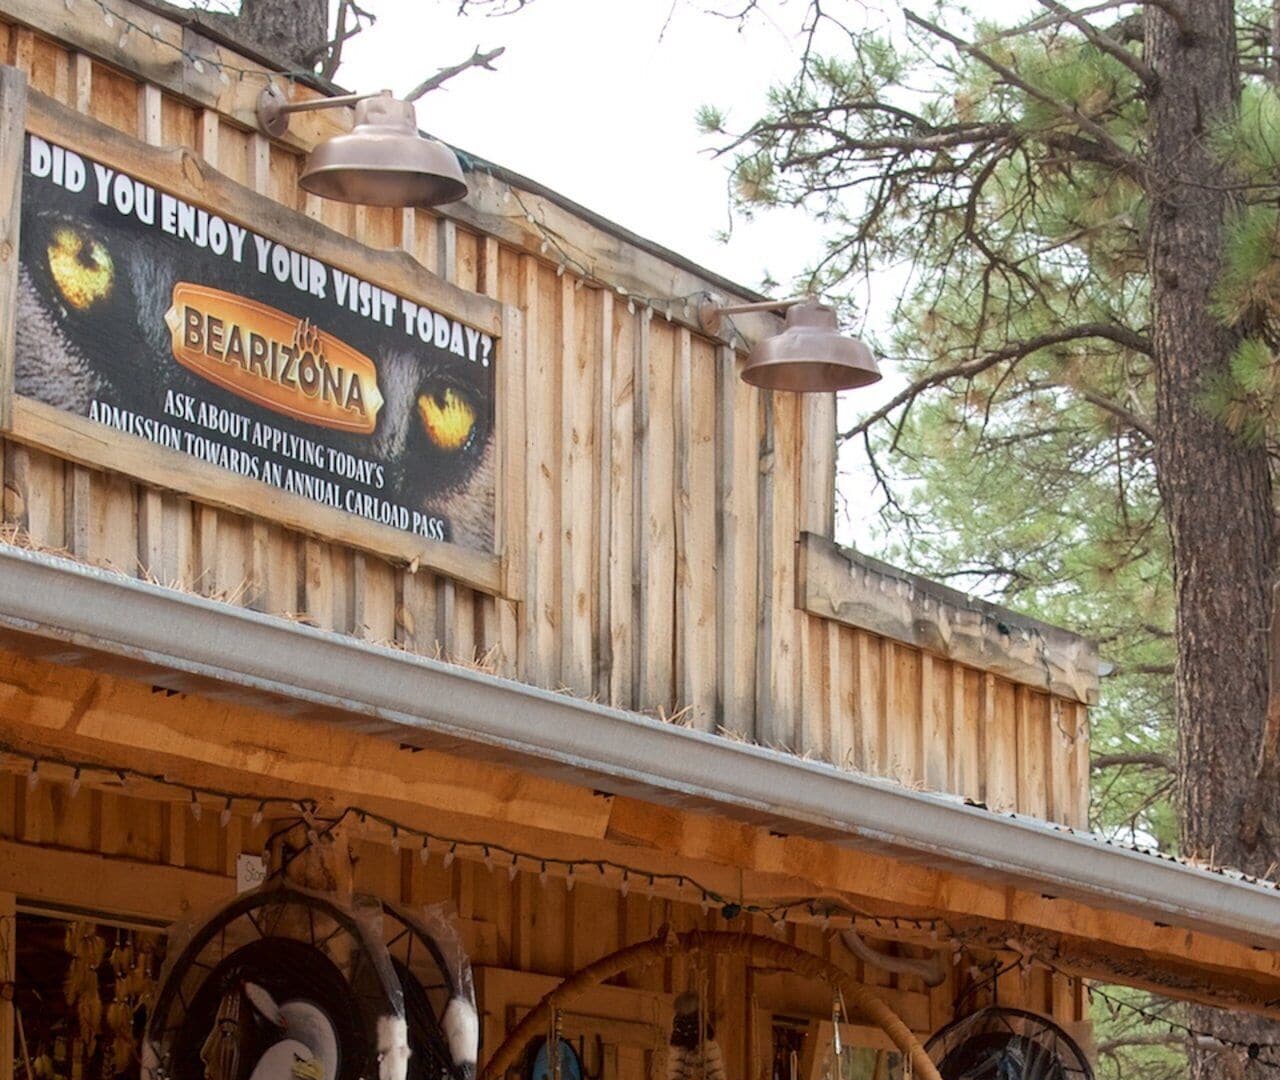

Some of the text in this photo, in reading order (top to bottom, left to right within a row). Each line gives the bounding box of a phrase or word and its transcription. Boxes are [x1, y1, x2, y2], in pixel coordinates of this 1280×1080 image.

[29, 134, 493, 368] DID YOU ENJOY YOUR VISIT TODAY?
[183, 305, 367, 416] BEARIZONA
[88, 400, 445, 542] ADMISSION TOWARDS AN ANNUAL CARLOAD PASS
[163, 389, 384, 490] ASK ABOUT APPLYING TODAY'S
